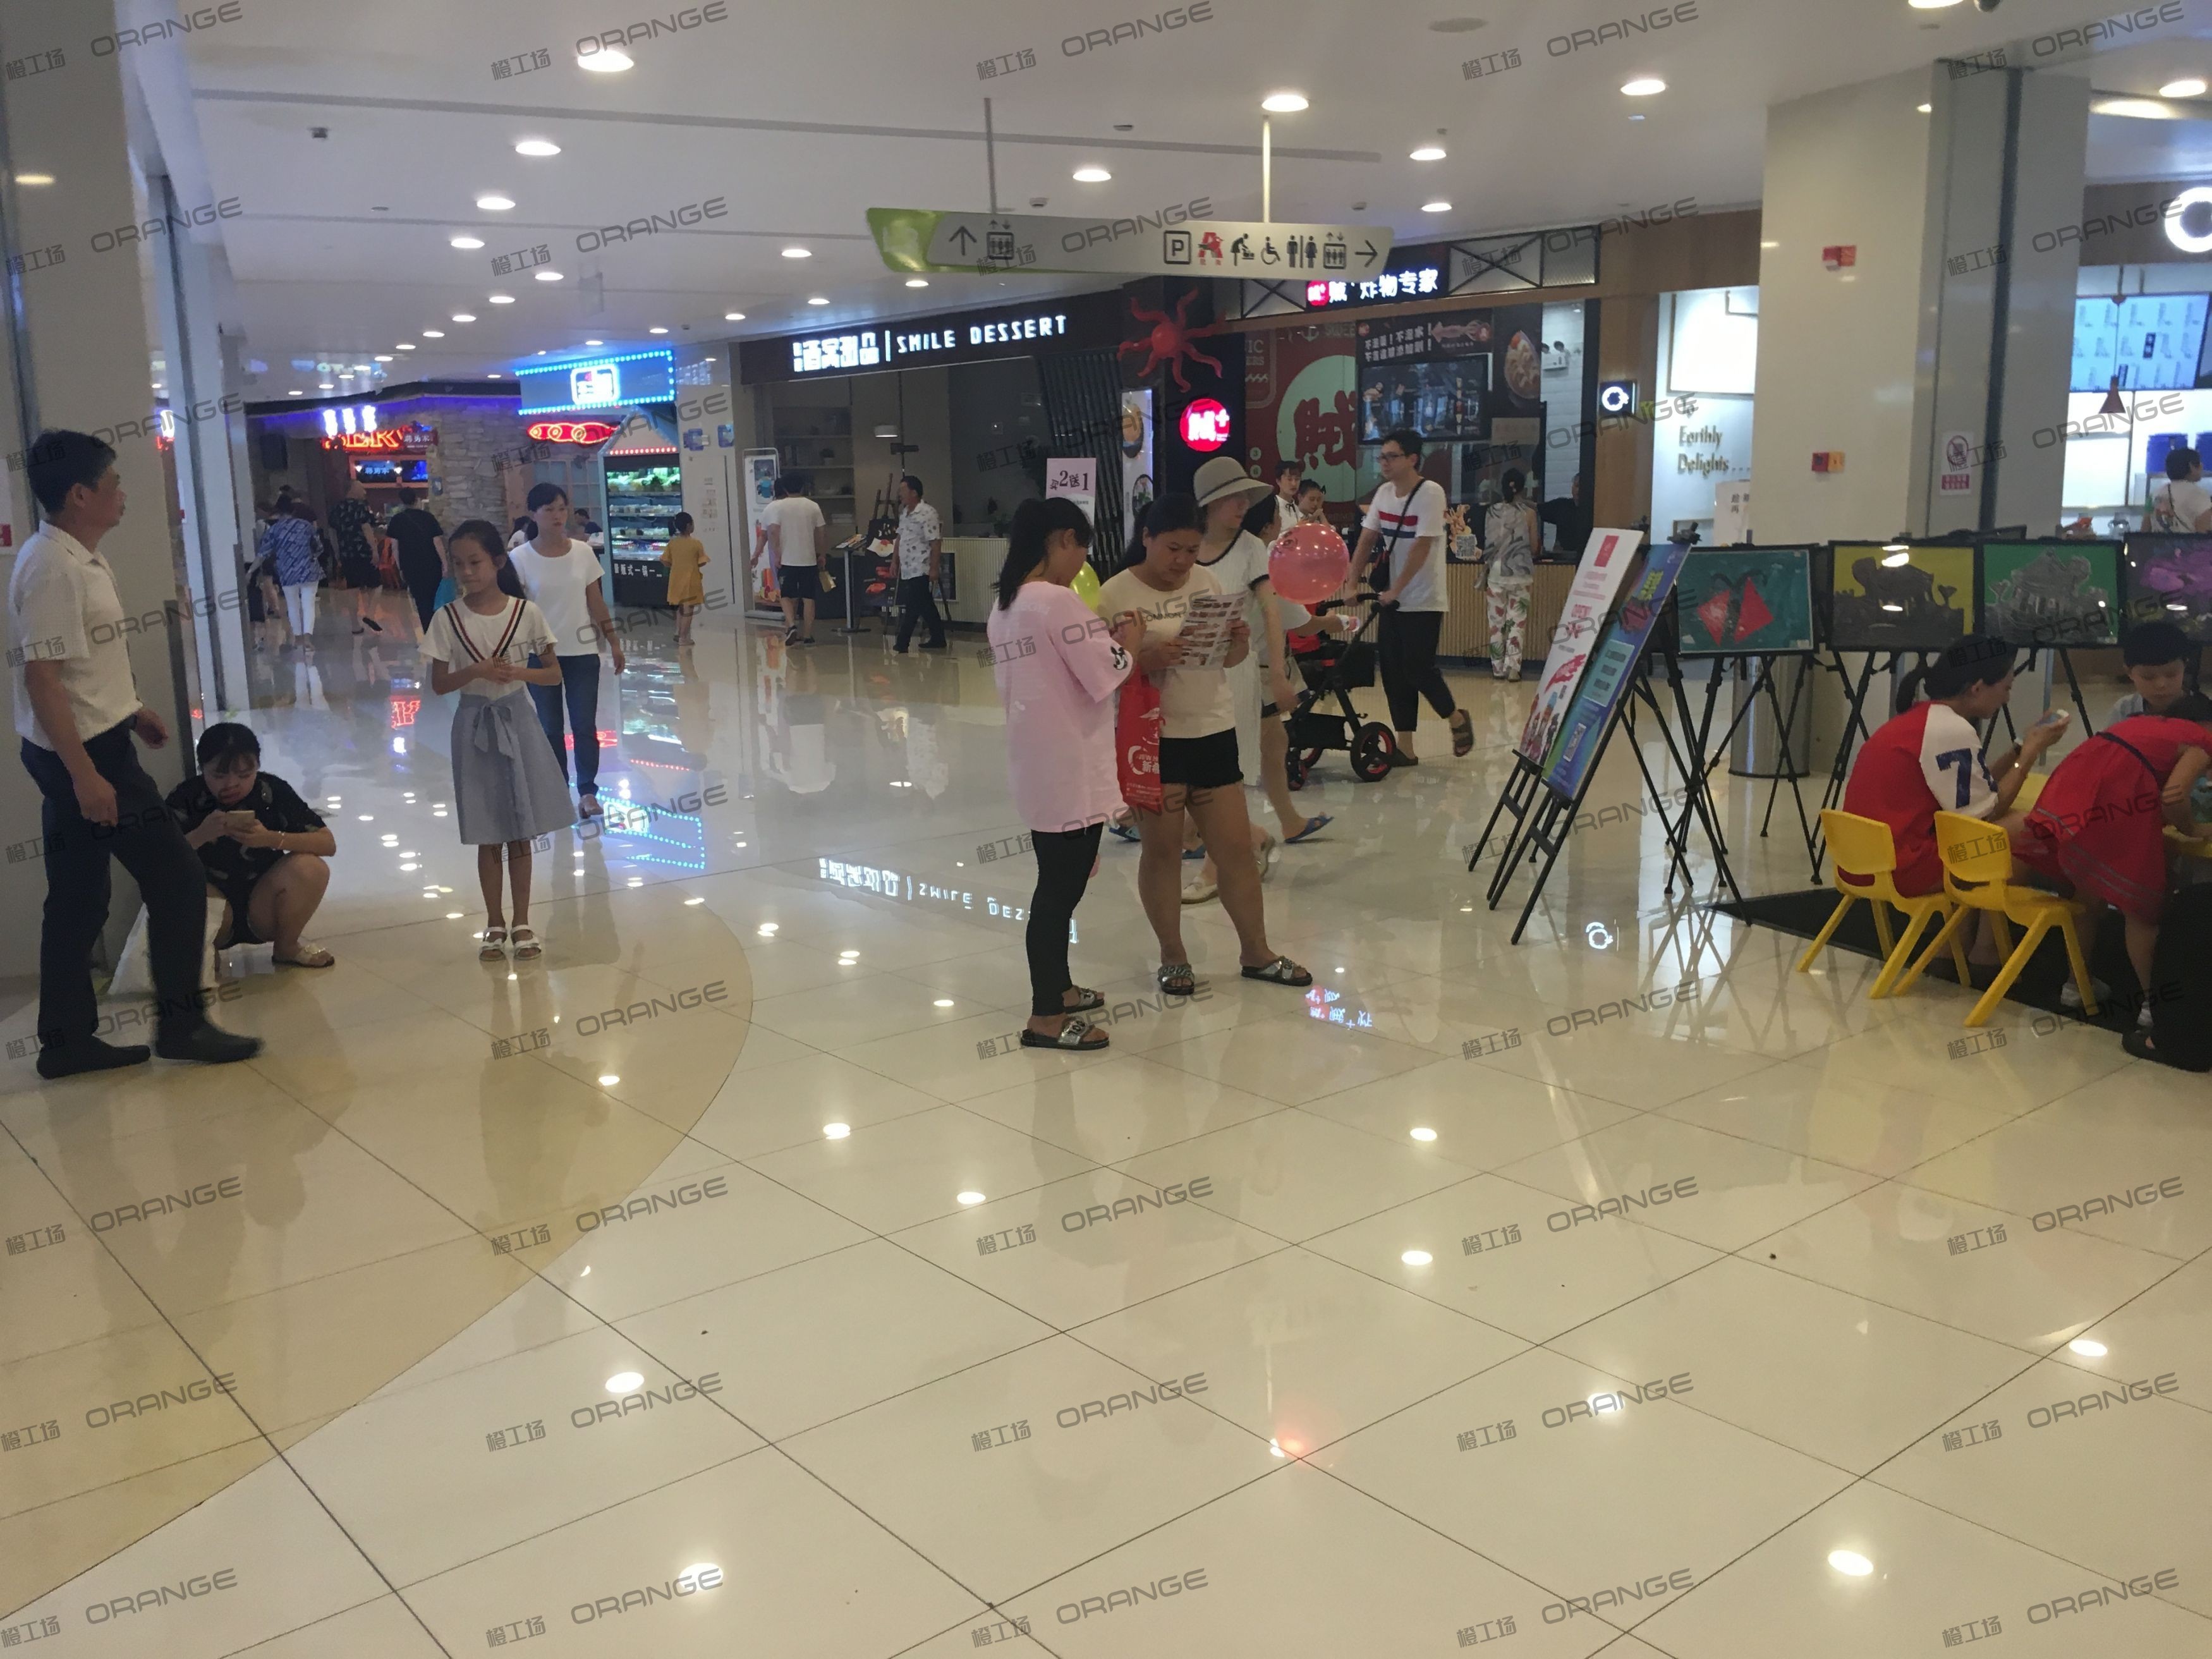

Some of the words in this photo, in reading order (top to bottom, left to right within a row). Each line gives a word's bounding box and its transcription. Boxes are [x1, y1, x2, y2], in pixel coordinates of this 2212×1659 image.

[897, 330, 956, 353] SMILE
[969, 315, 1067, 344] DESSERT
[1679, 425, 1723, 450] Earthly
[1050, 470, 1089, 491] 买2送1
